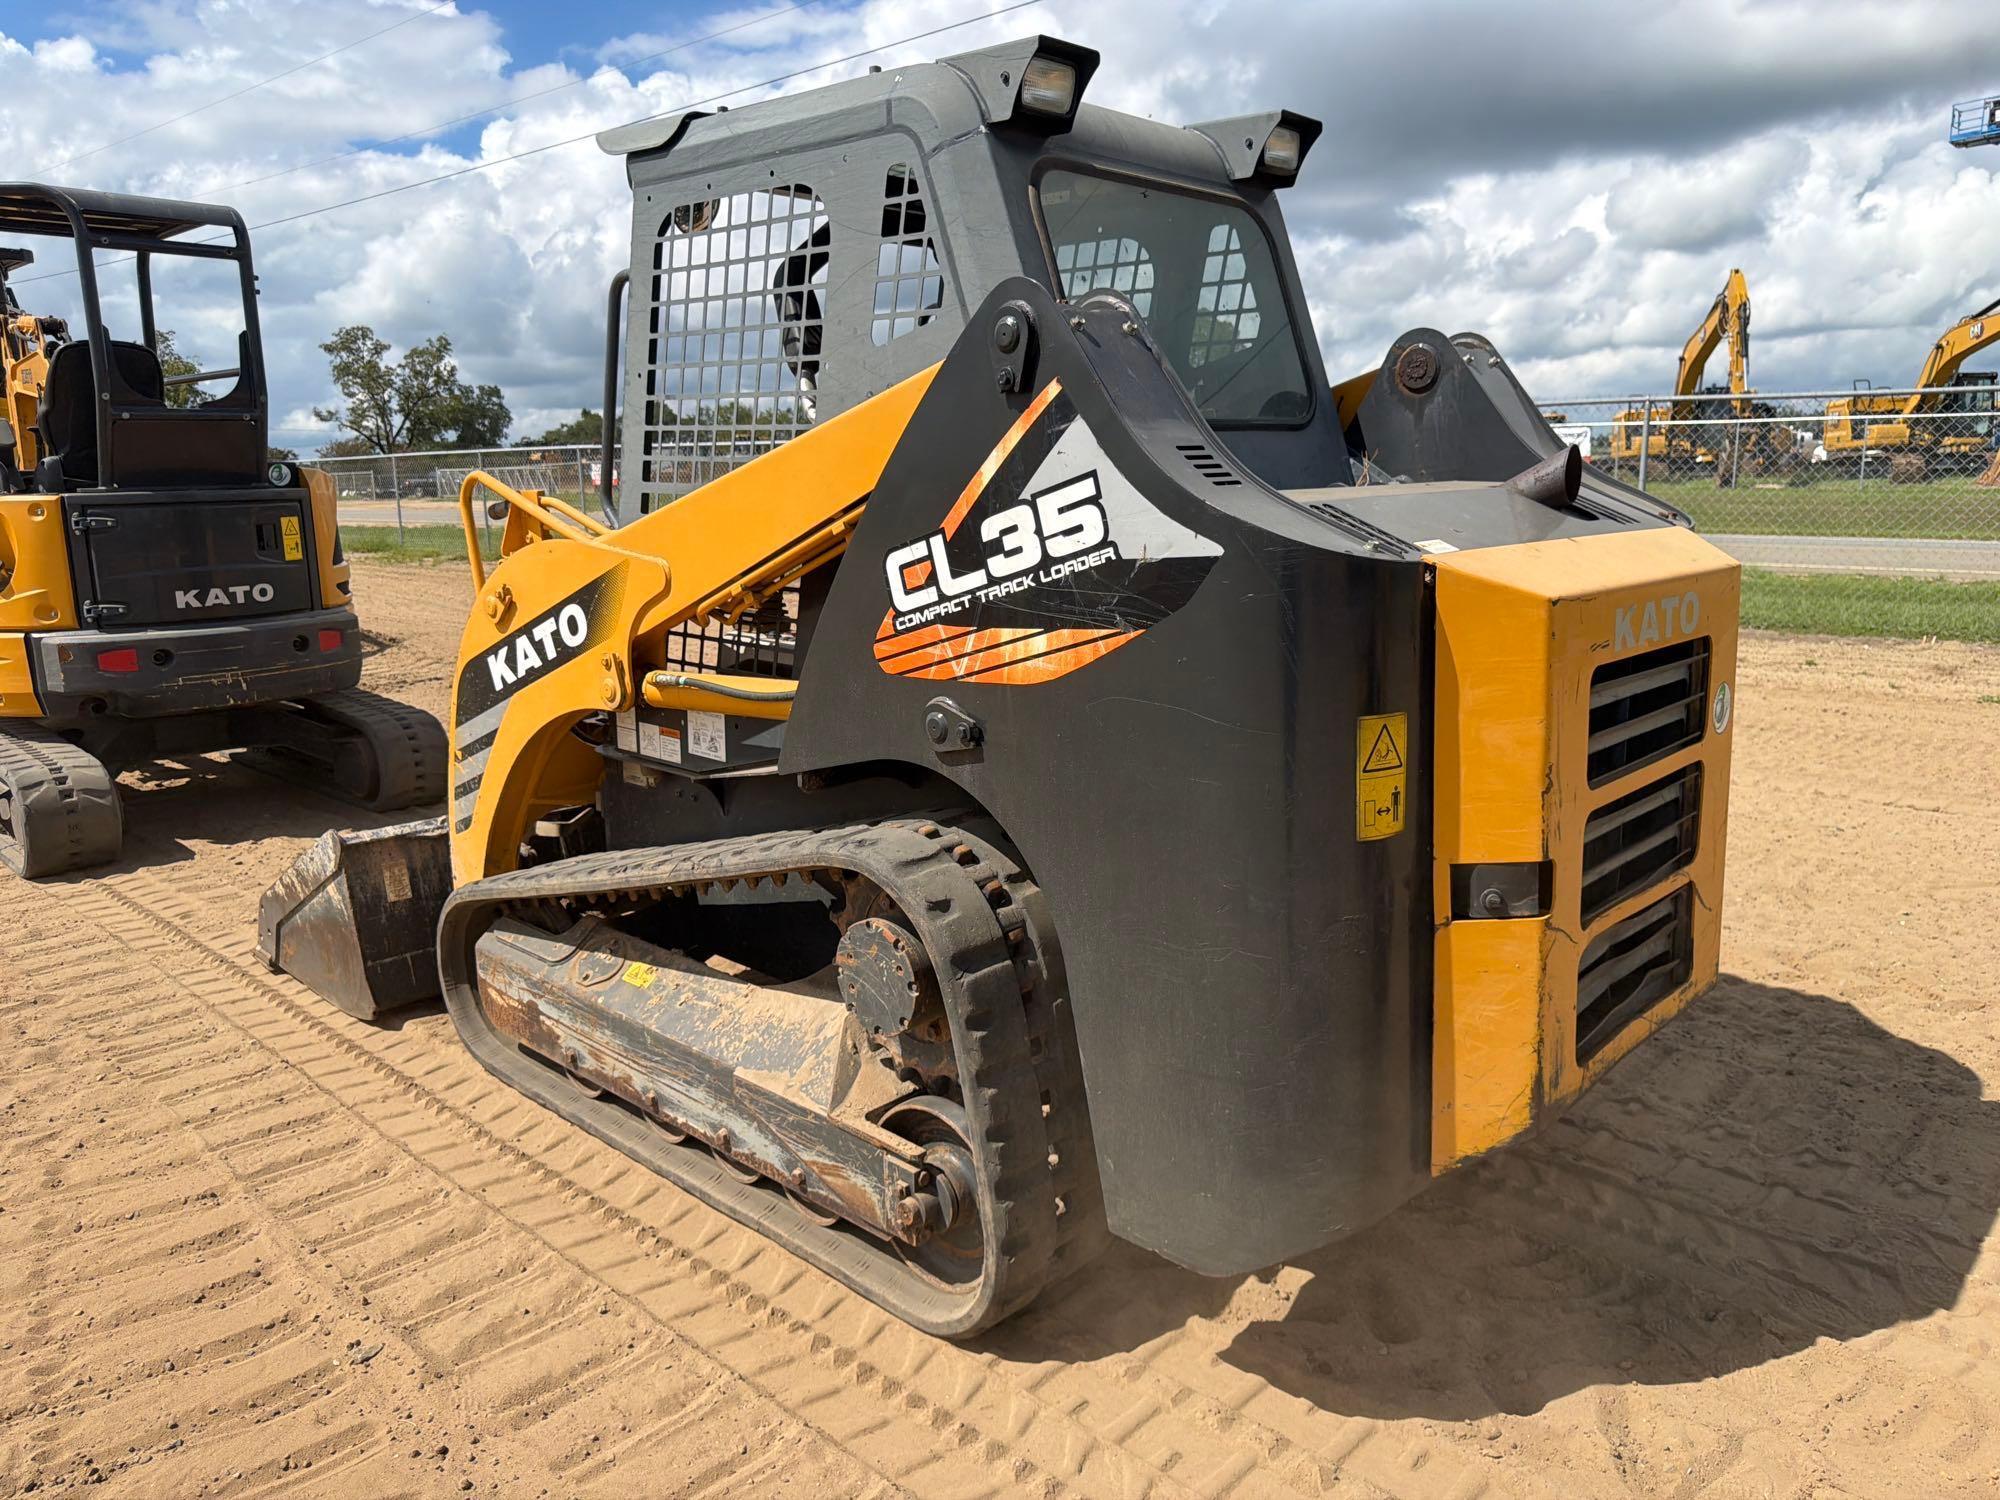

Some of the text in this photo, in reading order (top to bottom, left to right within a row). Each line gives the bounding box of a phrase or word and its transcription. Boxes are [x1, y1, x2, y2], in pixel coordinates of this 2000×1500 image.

[885, 476, 1105, 613] CL35
[174, 582, 275, 609] KATO
[895, 546, 1117, 631] COMPACT TRACK LOADER
[1614, 591, 1700, 653] KATO
[486, 603, 588, 692] KATO
